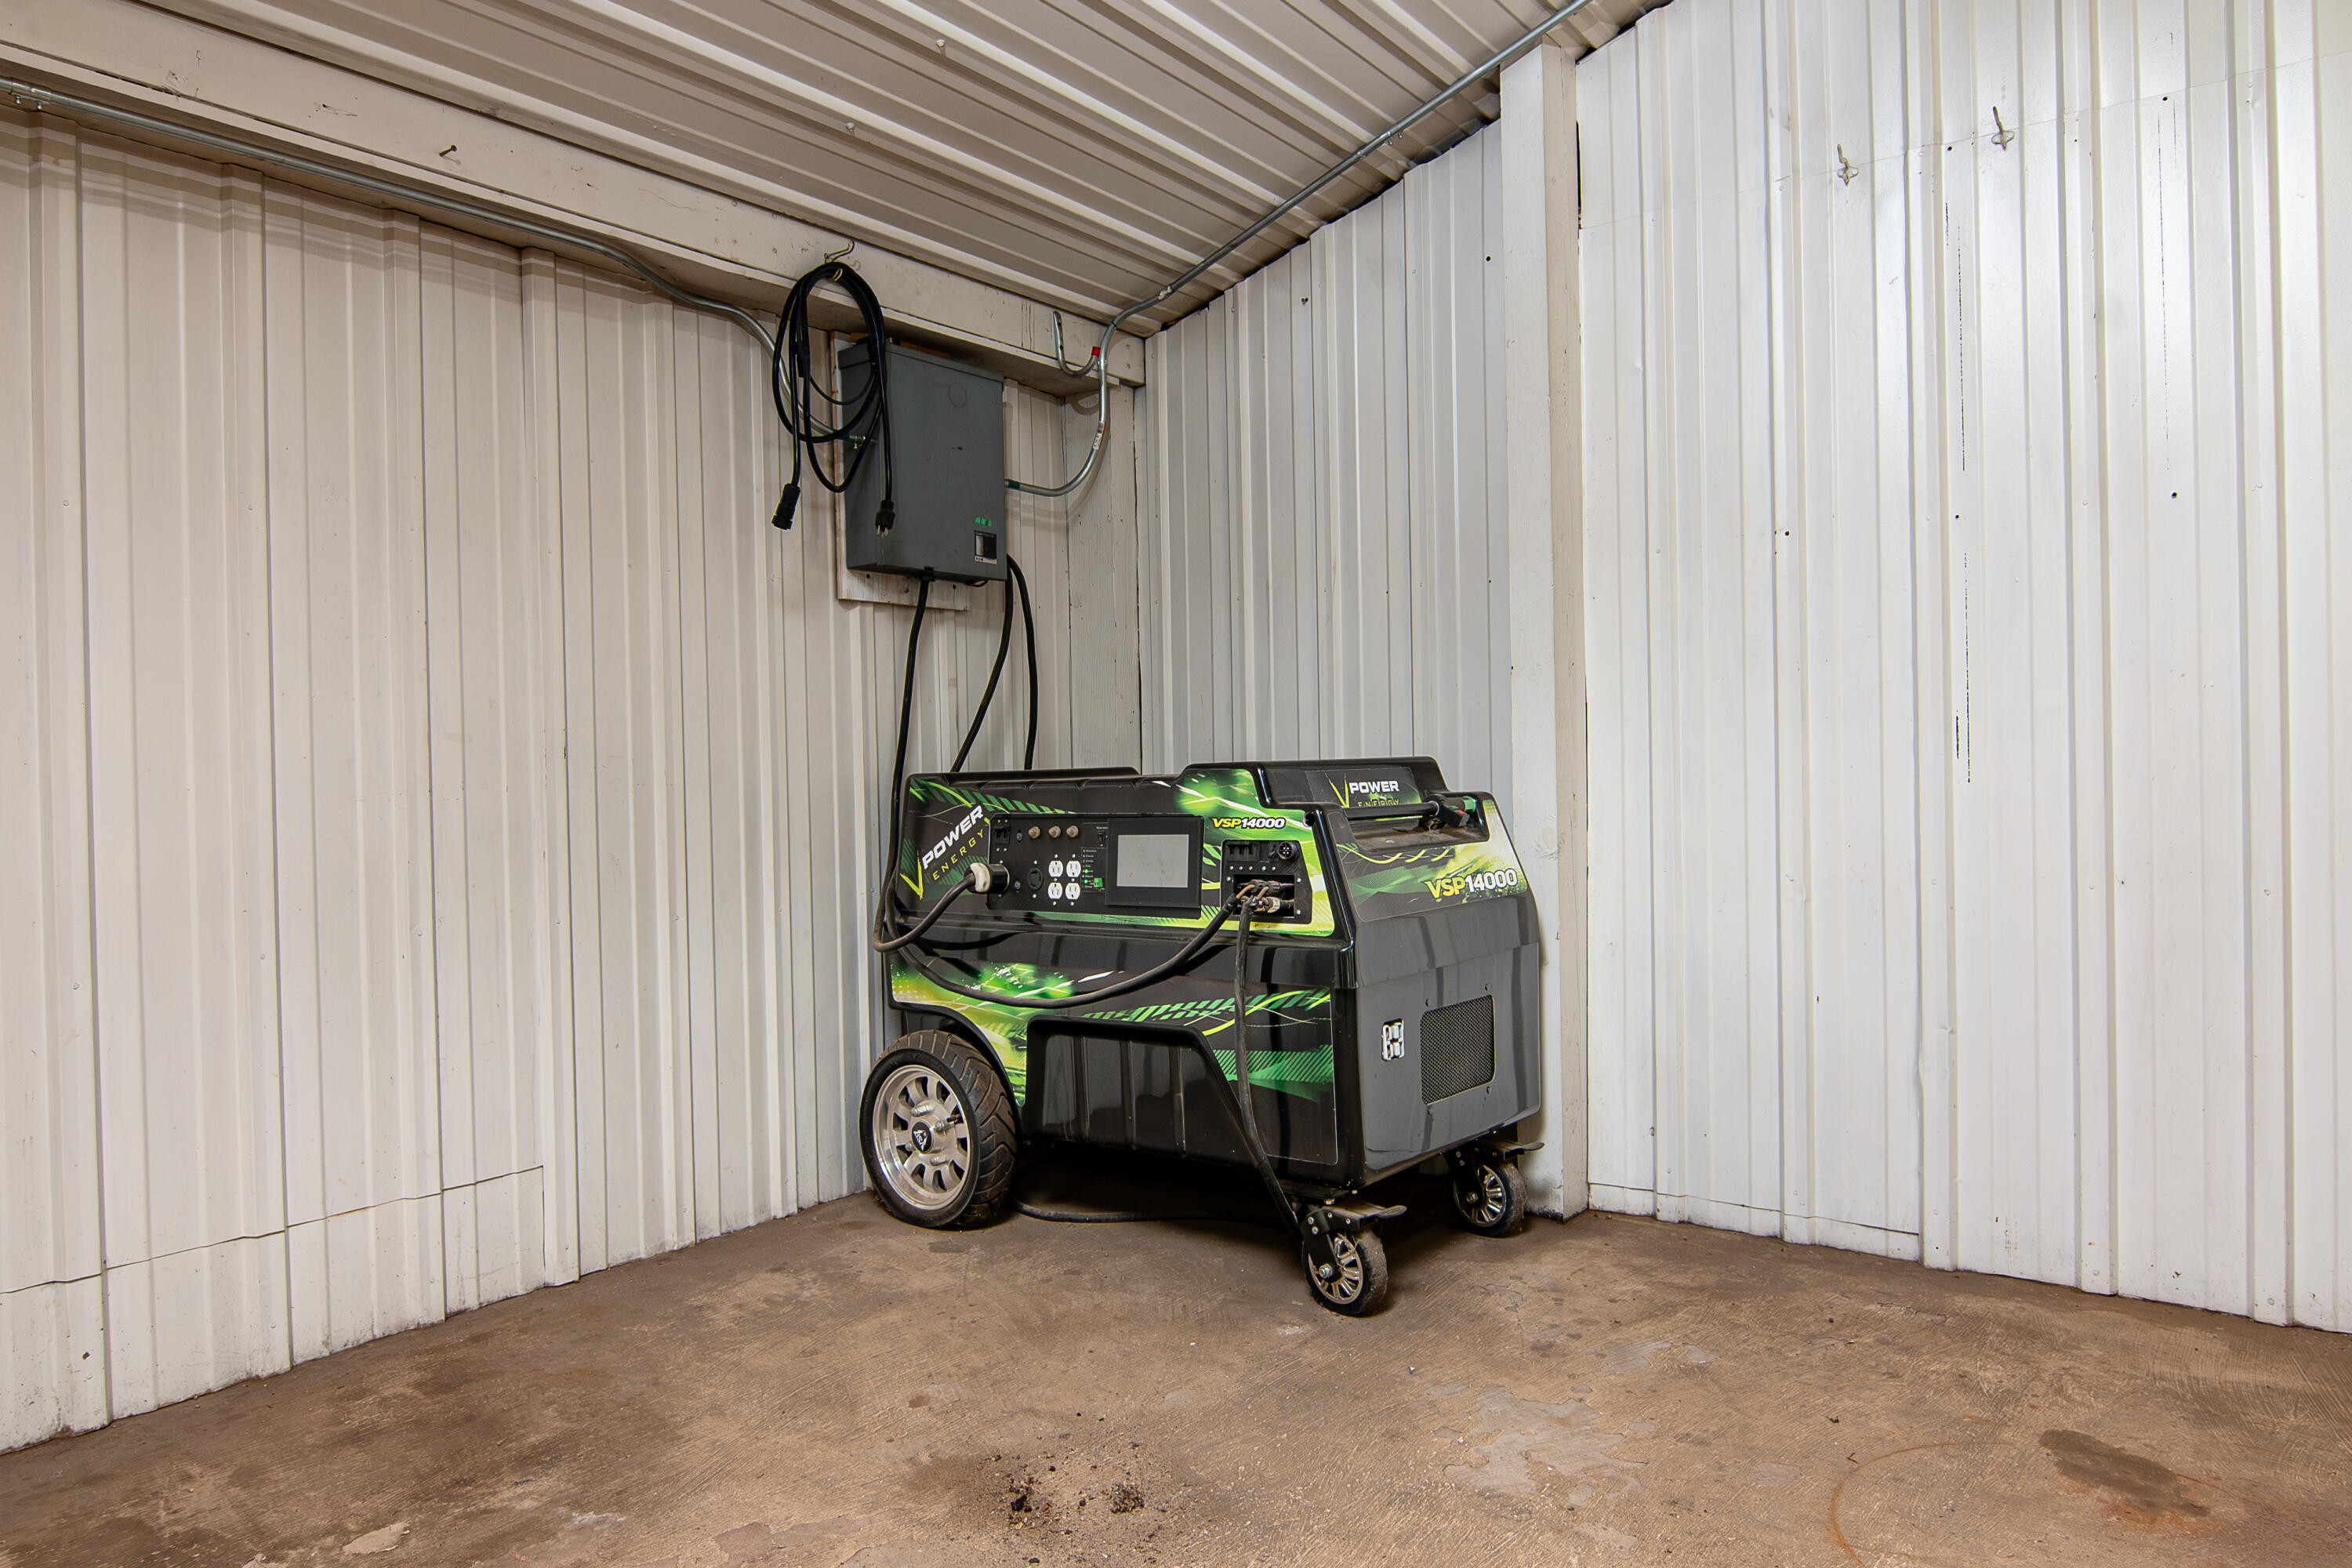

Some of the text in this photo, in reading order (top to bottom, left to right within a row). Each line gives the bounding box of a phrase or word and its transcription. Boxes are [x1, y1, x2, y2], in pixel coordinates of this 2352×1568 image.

[1211, 817, 1287, 829] VSP14000
[931, 828, 984, 880] ENERGY
[1424, 868, 1519, 899] VSP14000
